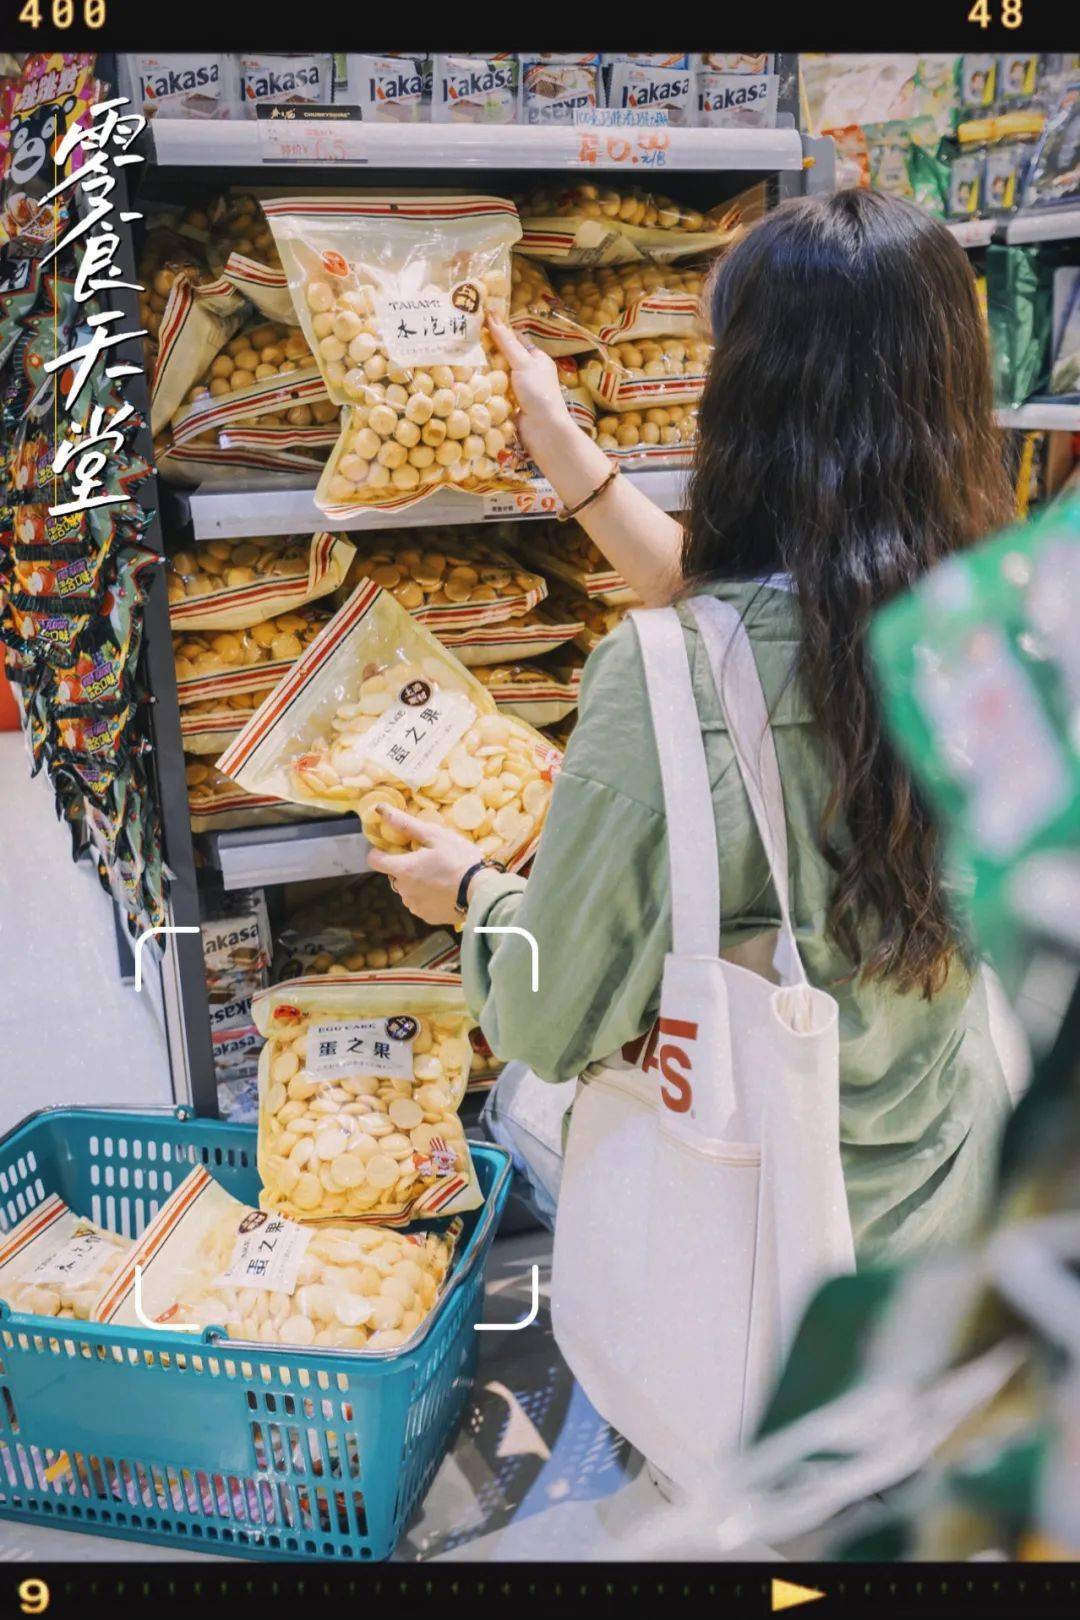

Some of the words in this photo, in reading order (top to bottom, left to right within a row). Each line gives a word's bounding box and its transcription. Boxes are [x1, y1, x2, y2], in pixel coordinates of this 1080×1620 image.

[140, 64, 219, 101] Kakasa
[240, 66, 319, 102] Kakasa
[622, 78, 689, 108] Kakasa
[698, 82, 767, 112] Kakasa
[319, 1037, 391, 1059] 蛋之果
